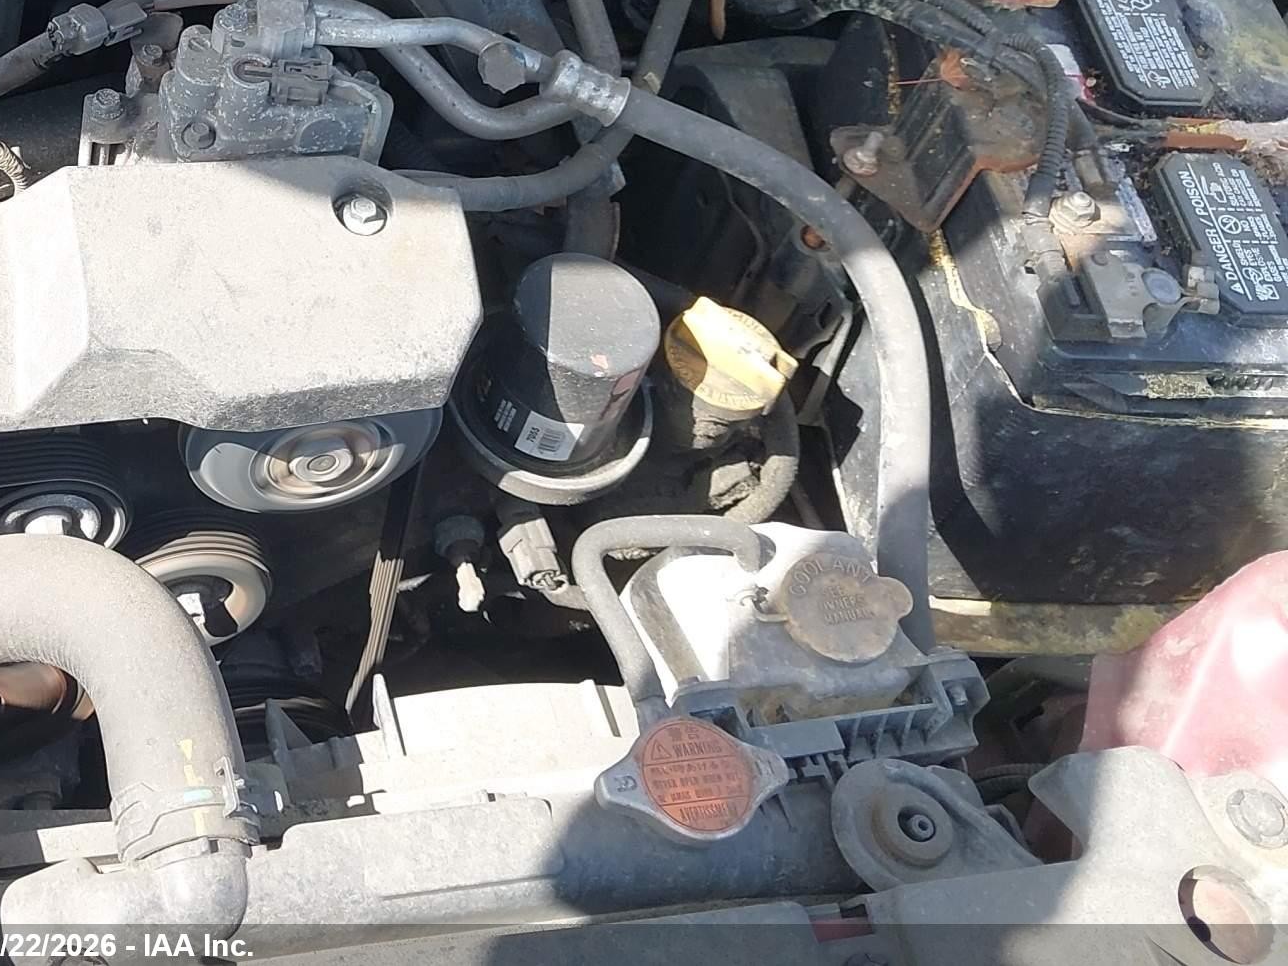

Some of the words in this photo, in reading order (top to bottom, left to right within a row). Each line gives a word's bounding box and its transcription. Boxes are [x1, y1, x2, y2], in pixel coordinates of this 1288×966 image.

[1178, 170, 1209, 216] POISON
[1240, 219, 1251, 232] NO
[1205, 228, 1239, 281] DANGER
[672, 740, 723, 758] WARNING
